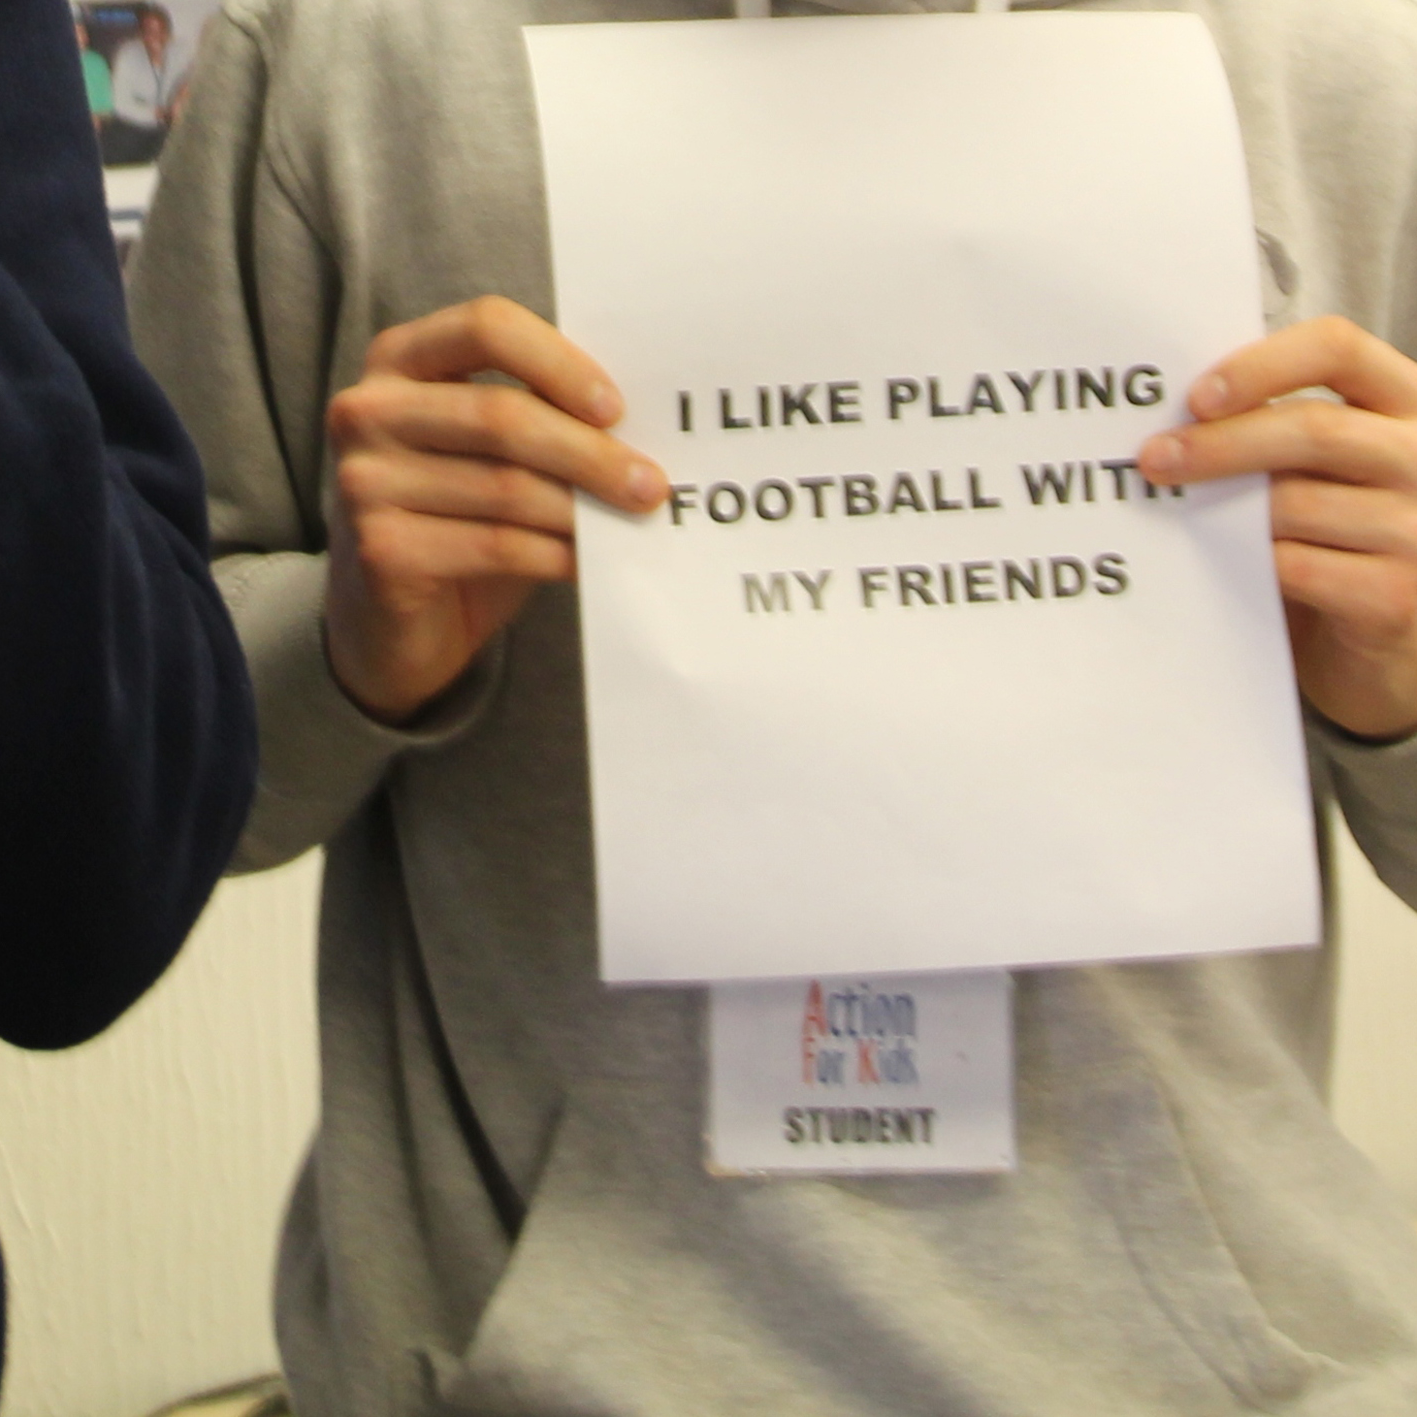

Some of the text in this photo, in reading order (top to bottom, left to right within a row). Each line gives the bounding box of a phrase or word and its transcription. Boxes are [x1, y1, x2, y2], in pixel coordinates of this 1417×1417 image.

[678, 363, 1165, 432] I LIKE PLAYING
[668, 457, 1184, 525] FOOTBALL WIT
[740, 552, 1130, 614] MY FRIENDS
[802, 980, 917, 1038] Action
[784, 1106, 935, 1144] STUDENT
